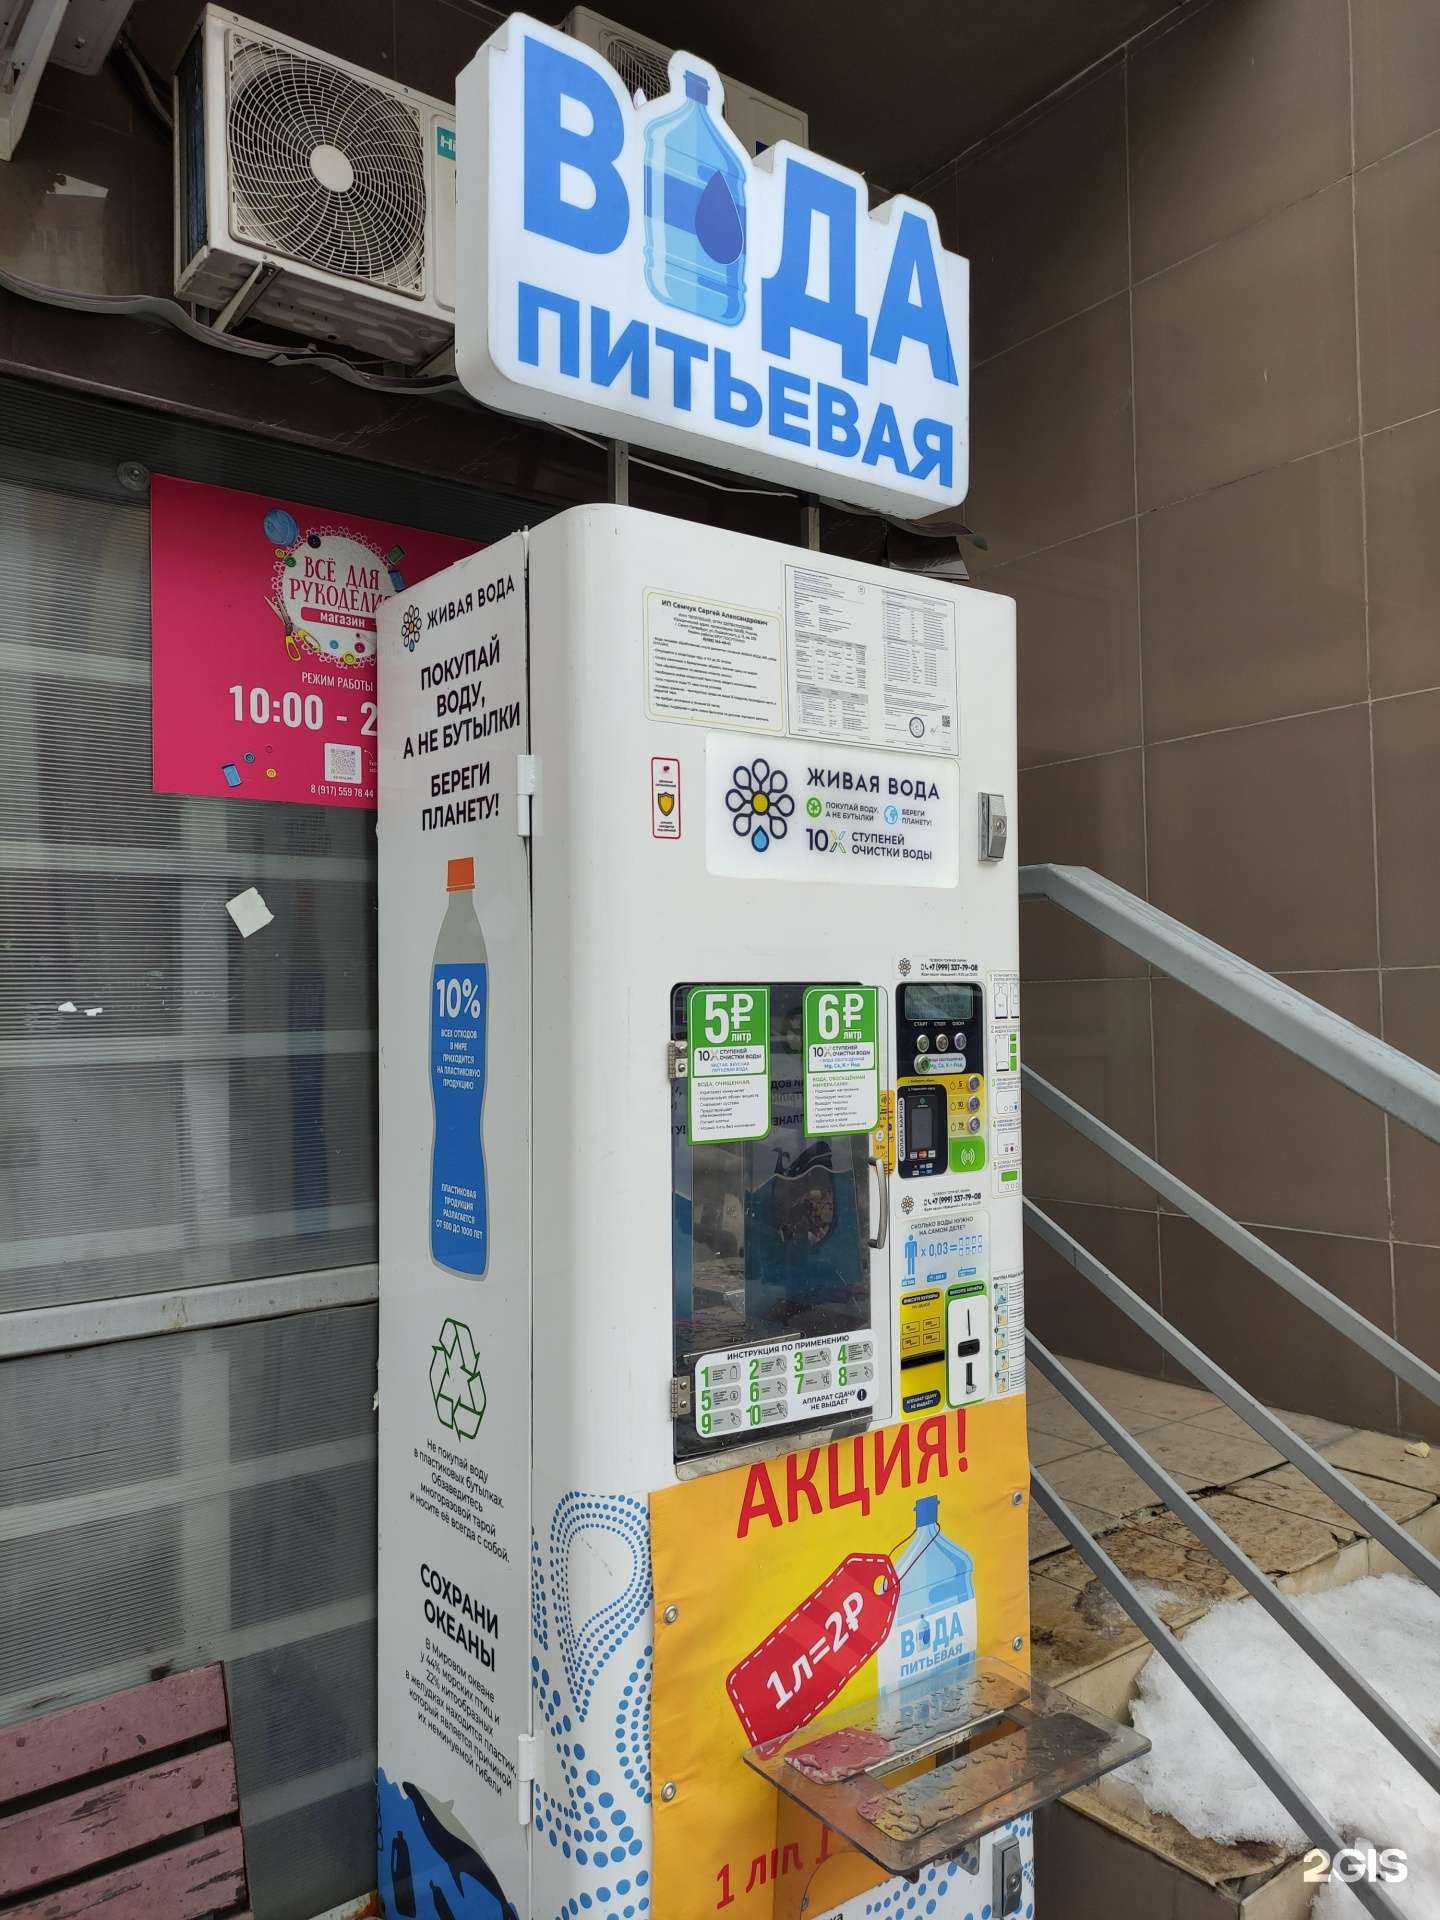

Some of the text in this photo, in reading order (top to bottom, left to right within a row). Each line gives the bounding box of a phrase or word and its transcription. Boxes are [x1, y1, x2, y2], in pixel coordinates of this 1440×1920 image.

[518, 281, 953, 489] ПИТЬЕВАЯ
[304, 555, 380, 590] ВСЁ ДЛЯ
[289, 577, 391, 613] РУКОДЕЛИ
[426, 574, 515, 630] ЖИВАЯ ВОДА
[320, 612, 365, 628] магазин
[420, 633, 500, 691] ПОКУПАЙ
[302, 671, 373, 693] РЕЖИМ РАБОТЫ
[437, 681, 486, 717] ВОДУ,
[229, 685, 324, 731] 10:00
[403, 701, 521, 760] А НЕ БУТЫЛКИ
[317, 784, 337, 797] (917)
[338, 786, 353, 797] 559
[354, 788, 363, 798] 78
[364, 789, 374, 799] 44
[431, 761, 490, 798] БЕРЕГИ
[806, 767, 940, 801] ЖИВАЯ ВОДА
[422, 793, 500, 831] ПЛАНЕТУ!
[825, 801, 859, 812] ПОКУПАЙ
[832, 811, 841, 819] НЕ
[842, 812, 874, 822] БУТЫЛКИ
[901, 808, 925, 817] БЕРЕГИ
[901, 817, 932, 827] ПЛАНЕТУ!
[851, 831, 905, 845] СТУПЕНЕЙ
[851, 844, 932, 861] ОЧИСТКИ ВОДЫ
[436, 977, 481, 1019] 10%
[928, 1241, 948, 1259] 0,03
[727, 1334, 850, 1361] ИНСТРУКЦИЯ ПО ПРИМЕНЕНИЮ
[794, 1351, 804, 1372] 3
[837, 1344, 848, 1365] 4
[701, 1366, 709, 1388] 1
[749, 1359, 760, 1380] 2
[794, 1374, 805, 1395] 7
[838, 1366, 848, 1387] 8
[701, 1390, 712, 1411] 5
[750, 1382, 760, 1402] 6
[802, 1389, 857, 1406] АППАРАТ СДАЧУ
[810, 1398, 849, 1411] НЕ ВЫДАЕТ
[701, 1413, 712, 1435] 9
[746, 1404, 761, 1426] 10
[419, 1450, 465, 1484] пластиковых
[427, 1438, 488, 1484] Не покупай воду
[736, 1408, 969, 1540] АКЦИЯ!
[420, 1482, 496, 1537] многоразовой тарой
[431, 1472, 484, 1513] Обзаведитесь
[415, 1494, 440, 1518] носите
[450, 1517, 476, 1541] всегда
[477, 1534, 482, 1545] с
[420, 1563, 499, 1640] СОХРАНИ
[424, 1598, 495, 1673] ОКЕАНЫ
[425, 1637, 495, 1703] В Мировом океане
[900, 1643, 963, 1677] ПИТЬЕВАЯ
[410, 1675, 445, 1707] желудках
[445, 1703, 483, 1744] находится
[441, 1684, 494, 1737] китообразных
[442, 1668, 474, 1700] морских
[474, 1696, 494, 1722] птиц
[409, 1687, 512, 1790] который является причиной
[418, 1711, 427, 1726] их
[427, 1721, 474, 1769] неминуемой
